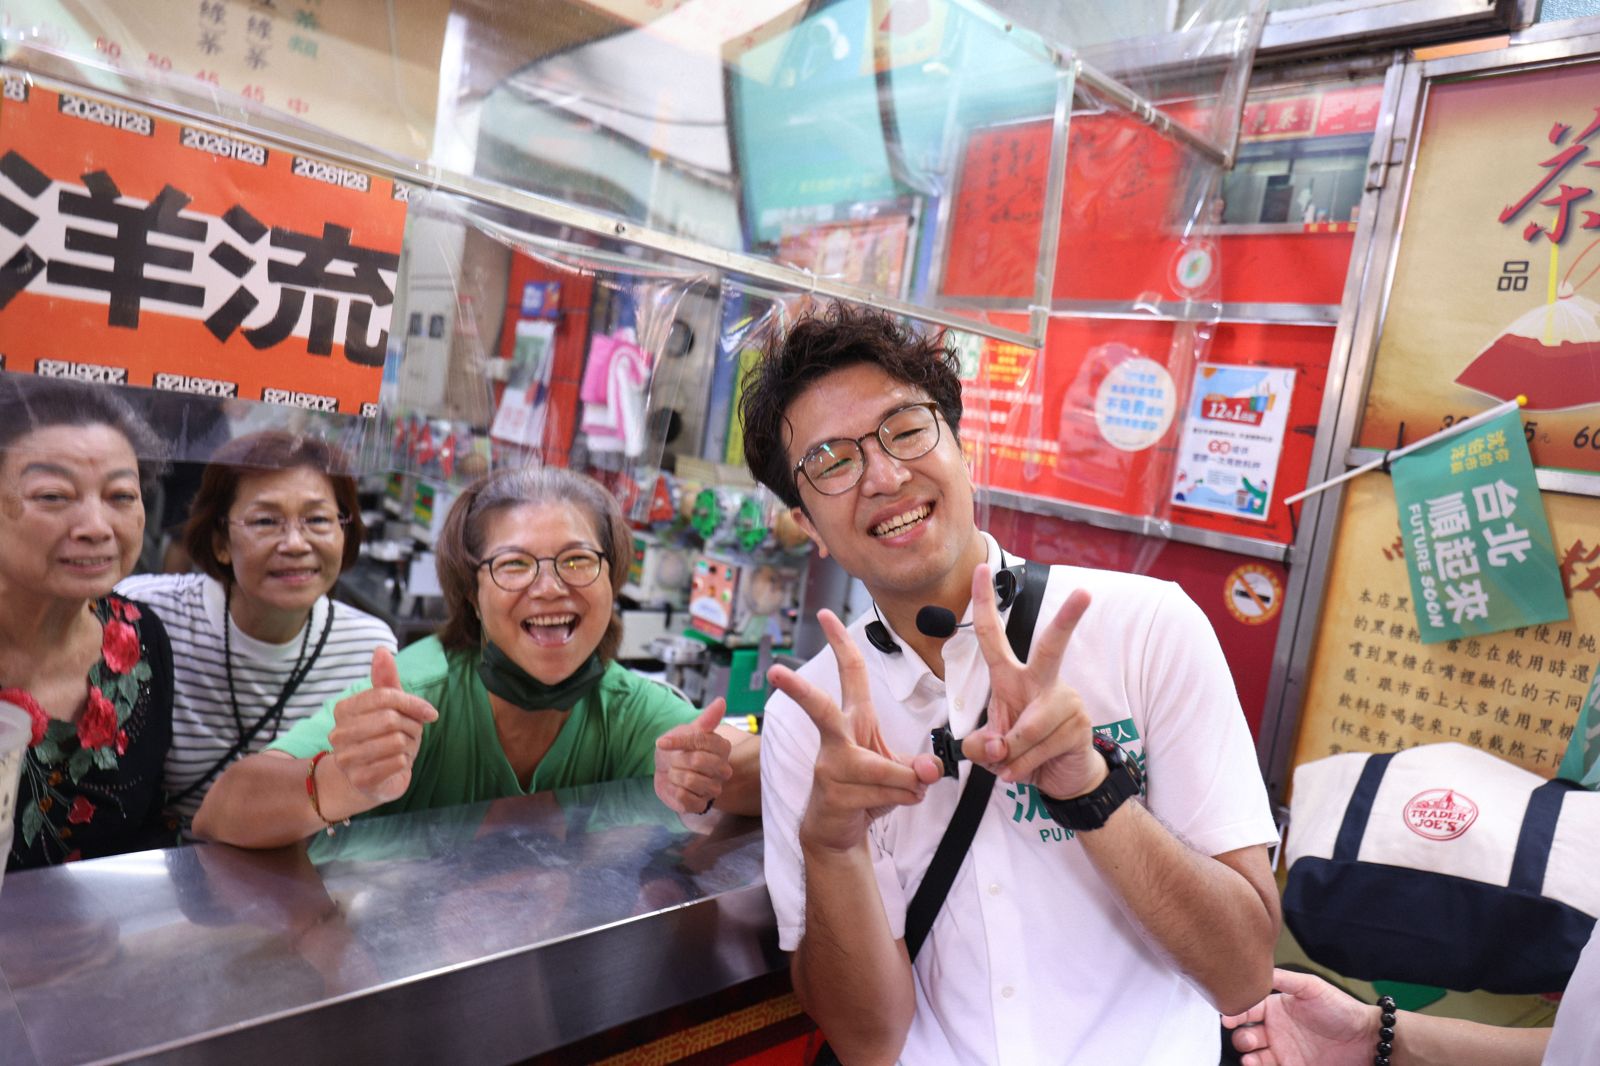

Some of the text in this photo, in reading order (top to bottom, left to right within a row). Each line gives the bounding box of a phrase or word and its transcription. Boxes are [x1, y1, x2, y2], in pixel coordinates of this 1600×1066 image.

[61, 95, 151, 136] 20261128
[183, 126, 266, 166] 20261128
[294, 157, 368, 192] 20261128
[1497, 260, 1530, 292] 品
[38, 358, 126, 386] 20261128
[156, 373, 236, 399] 20261128
[264, 387, 337, 413] 20261128
[1472, 479, 1532, 567] 台北
[1408, 503, 1445, 628] FUTURE SOON
[1425, 491, 1489, 624] 順起來
[1411, 809, 1467, 821] TRADER
[1414, 818, 1457, 832] JOE'S
